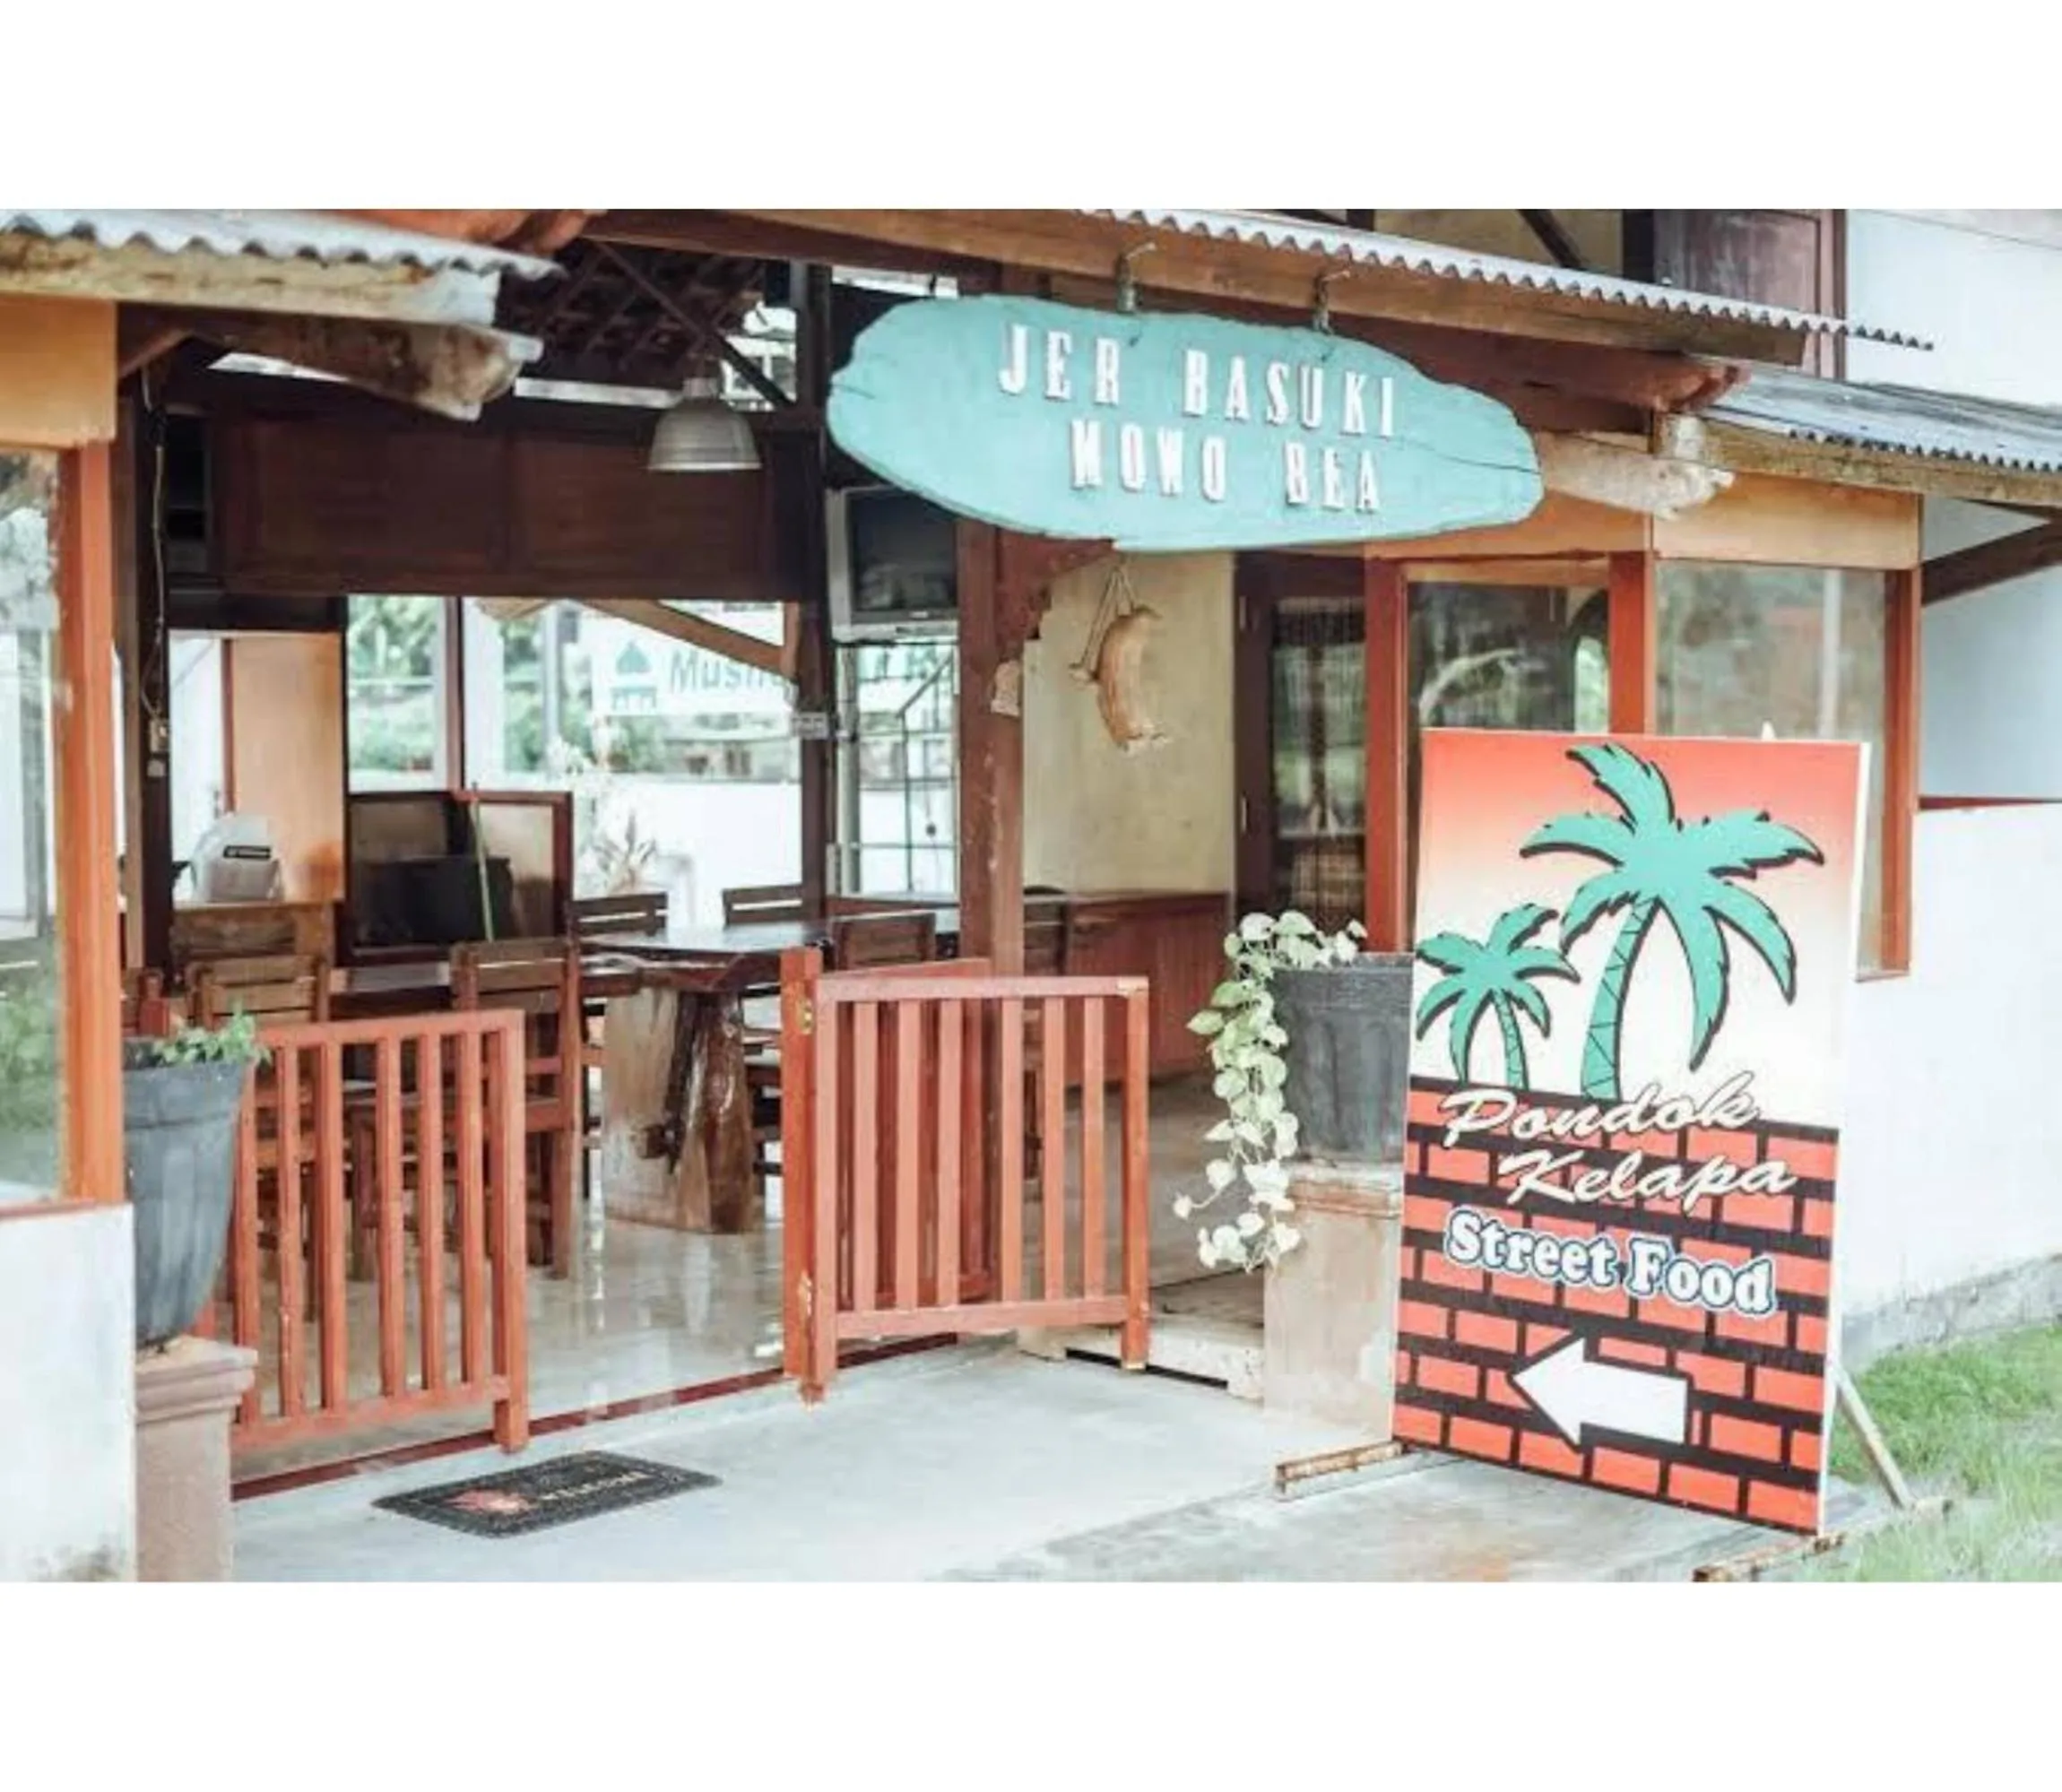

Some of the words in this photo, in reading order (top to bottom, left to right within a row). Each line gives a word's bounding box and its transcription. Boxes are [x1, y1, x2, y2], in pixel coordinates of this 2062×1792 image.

[998, 324, 1121, 406] JER
[1183, 349, 1395, 437] BASUKI
[1070, 418, 1226, 502] MOWO
[1285, 440, 1378, 514] BEA
[1439, 1070, 1760, 1148] Pondok
[1498, 1148, 1798, 1218] Kelapa
[1443, 1205, 1616, 1289] Street
[1624, 1235, 1776, 1318] Food
